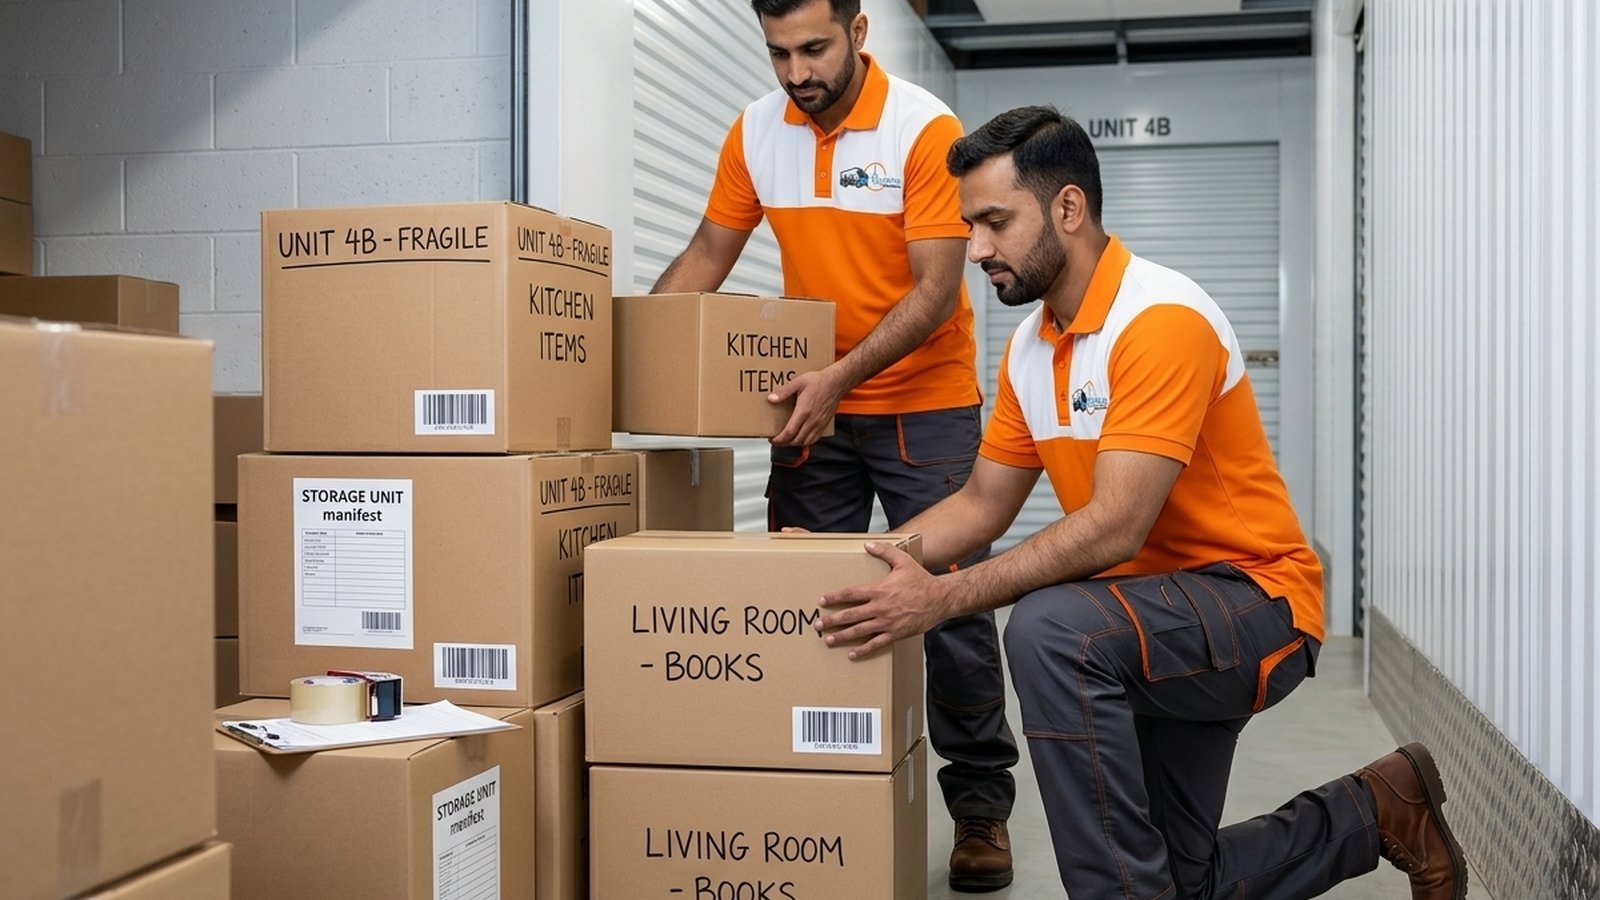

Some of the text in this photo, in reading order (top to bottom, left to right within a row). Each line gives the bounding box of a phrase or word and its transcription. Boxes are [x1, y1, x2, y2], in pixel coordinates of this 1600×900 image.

[1089, 116, 1171, 139] UNIT 4B
[278, 229, 336, 258] UNIT
[344, 227, 377, 255] 4B
[398, 225, 489, 252] FRAGILE
[517, 226, 546, 254] UNIT
[549, 233, 564, 258] 4B
[573, 238, 609, 266] FRAGILE
[529, 283, 594, 321] KITCHEN
[540, 331, 587, 363] ITEMS
[727, 332, 808, 359] KITCHEN
[302, 488, 404, 504] STORAGE UNIT
[540, 478, 568, 505] UNIT
[570, 476, 586, 503] 4B
[323, 508, 383, 522] manifest
[632, 605, 823, 638] LIVING ROOM
[665, 651, 764, 682] BOOKS
[437, 790, 475, 821] STORAGE
[646, 827, 844, 867] LIVING ROOM
[695, 876, 796, 900] BOOKS
